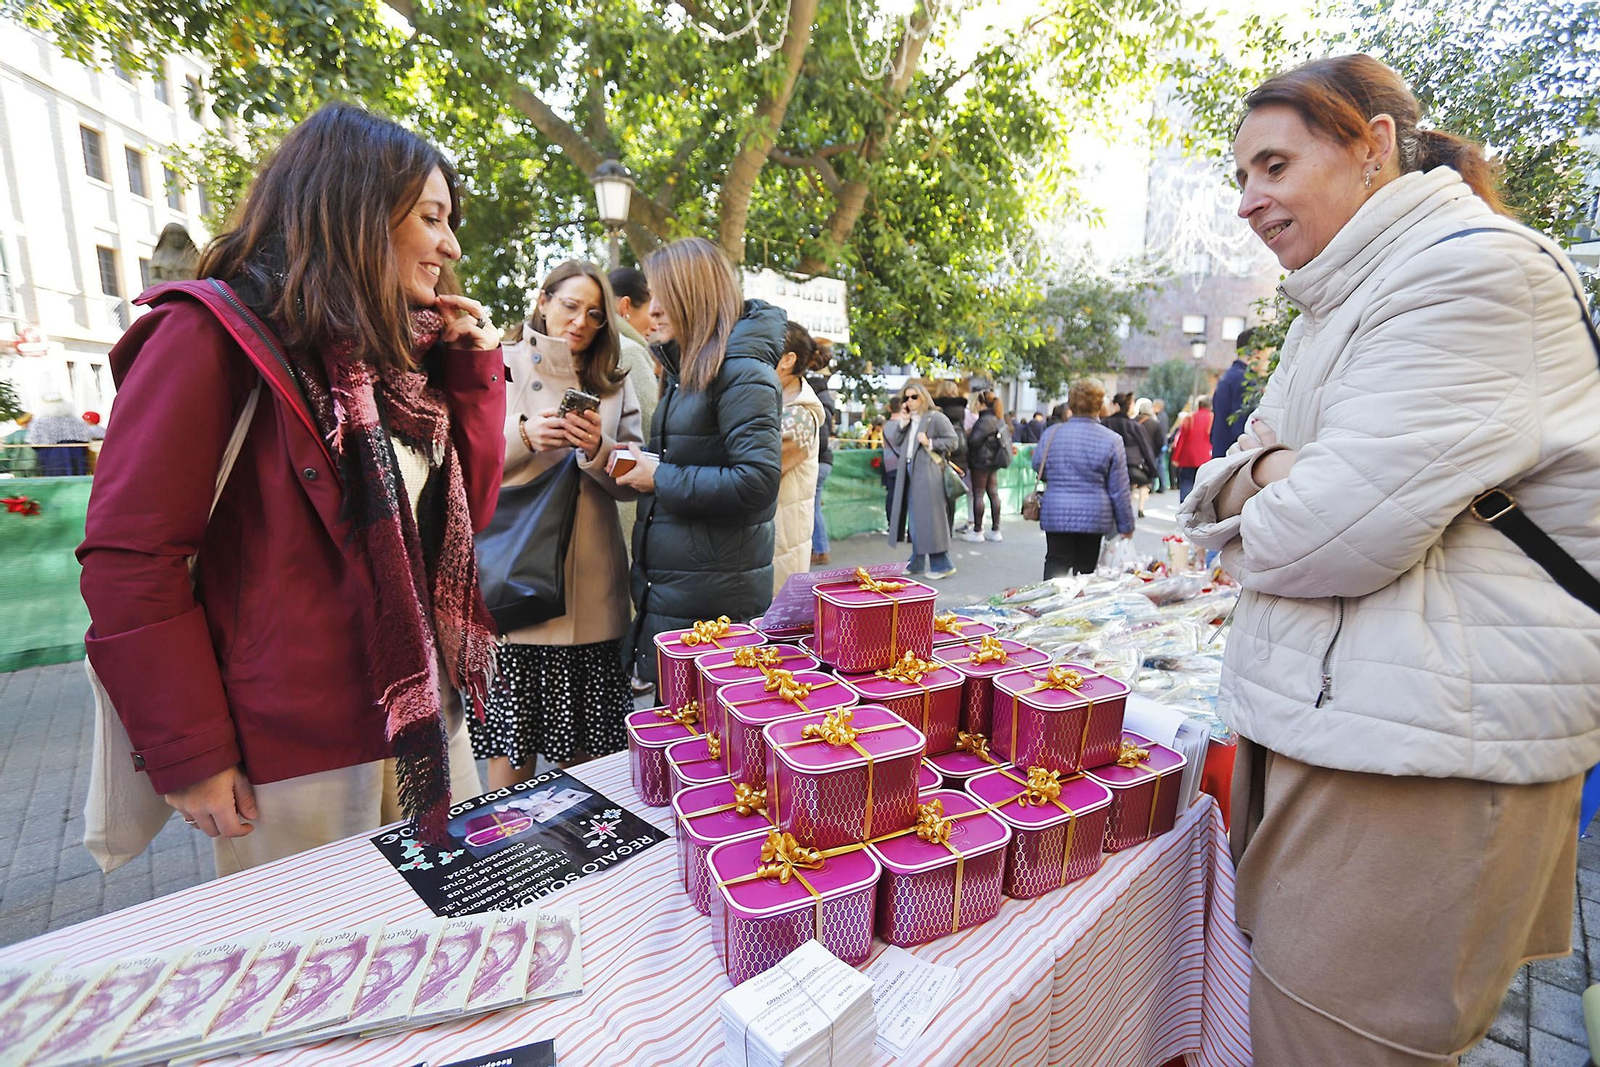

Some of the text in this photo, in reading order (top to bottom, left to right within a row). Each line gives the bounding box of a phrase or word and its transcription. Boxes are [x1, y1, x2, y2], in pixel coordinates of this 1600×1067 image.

[514, 770, 562, 792] Todo
[479, 787, 512, 805] por
[439, 843, 542, 892] Hermanas de la Cruz.
[443, 842, 525, 880] Calendario 2024.
[490, 855, 533, 879] donativo
[506, 853, 562, 882] Tupperware
[464, 876, 490, 892] para
[500, 835, 654, 913] REGALO SOLIDA
[446, 888, 465, 899] las
[450, 857, 571, 917] 12 Polvorones artesanos.
[461, 880, 506, 902] Baseline
[487, 876, 555, 912] Navidad 2023
[439, 901, 462, 912] 1,3L.
[889, 969, 906, 986] NAVIDAD
